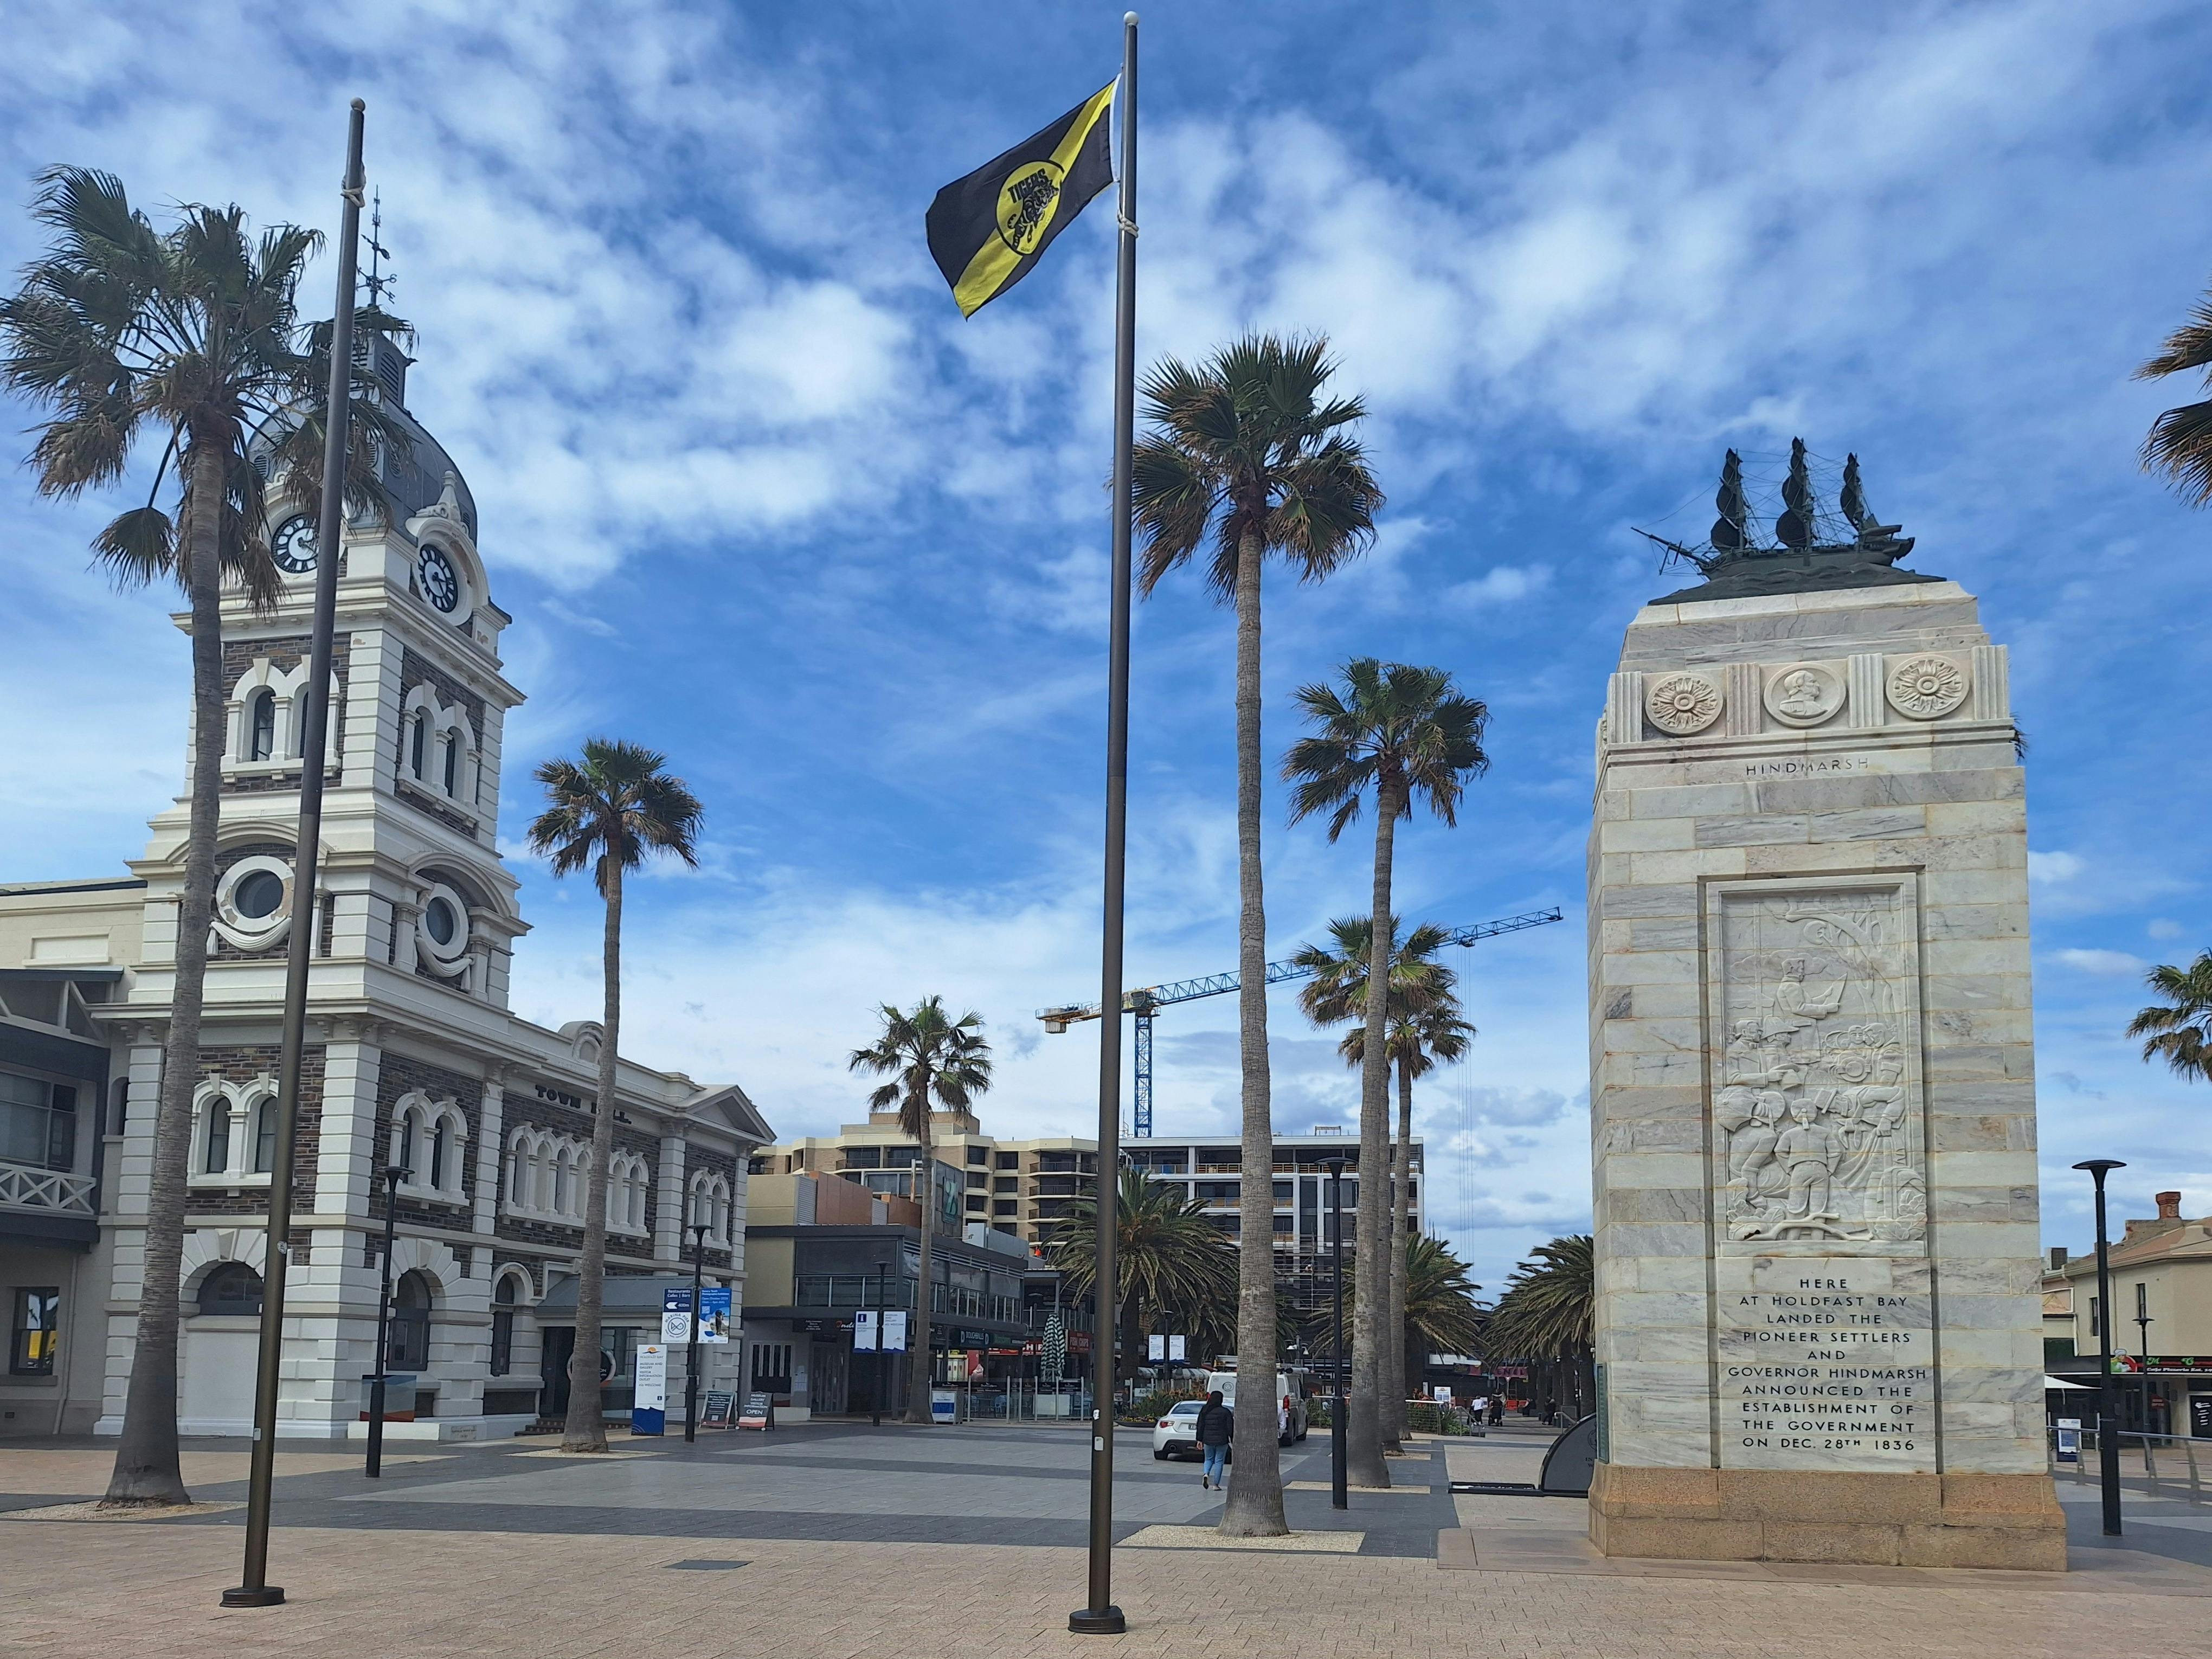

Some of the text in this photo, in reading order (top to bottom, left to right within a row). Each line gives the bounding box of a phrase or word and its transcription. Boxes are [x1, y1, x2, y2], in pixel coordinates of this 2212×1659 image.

[1007, 168, 1049, 203] TIGERS
[1746, 758, 1868, 776] HINDMARSH
[535, 1084, 582, 1109] TOWN
[1800, 1279, 1848, 1289] HERE
[1739, 1296, 1908, 1307] AT HOLDFAST BAY
[1767, 1314, 1882, 1324] LANDED THE
[1743, 1332, 1911, 1343] PIONEER SETTLERS
[1807, 1351, 1846, 1360] AND
[1728, 1367, 1926, 1379] GOVERNOR HINDMARSH
[1742, 1385, 1912, 1397] ANNOUNCED THE
[1742, 1403, 1914, 1415] ESTABLISHMENT OF
[1742, 1420, 1915, 1433] THE GOVERNMENT
[1742, 1437, 1768, 1448] ON
[1780, 1438, 1816, 1449] DEC.
[1875, 1439, 1914, 1450] 1836
